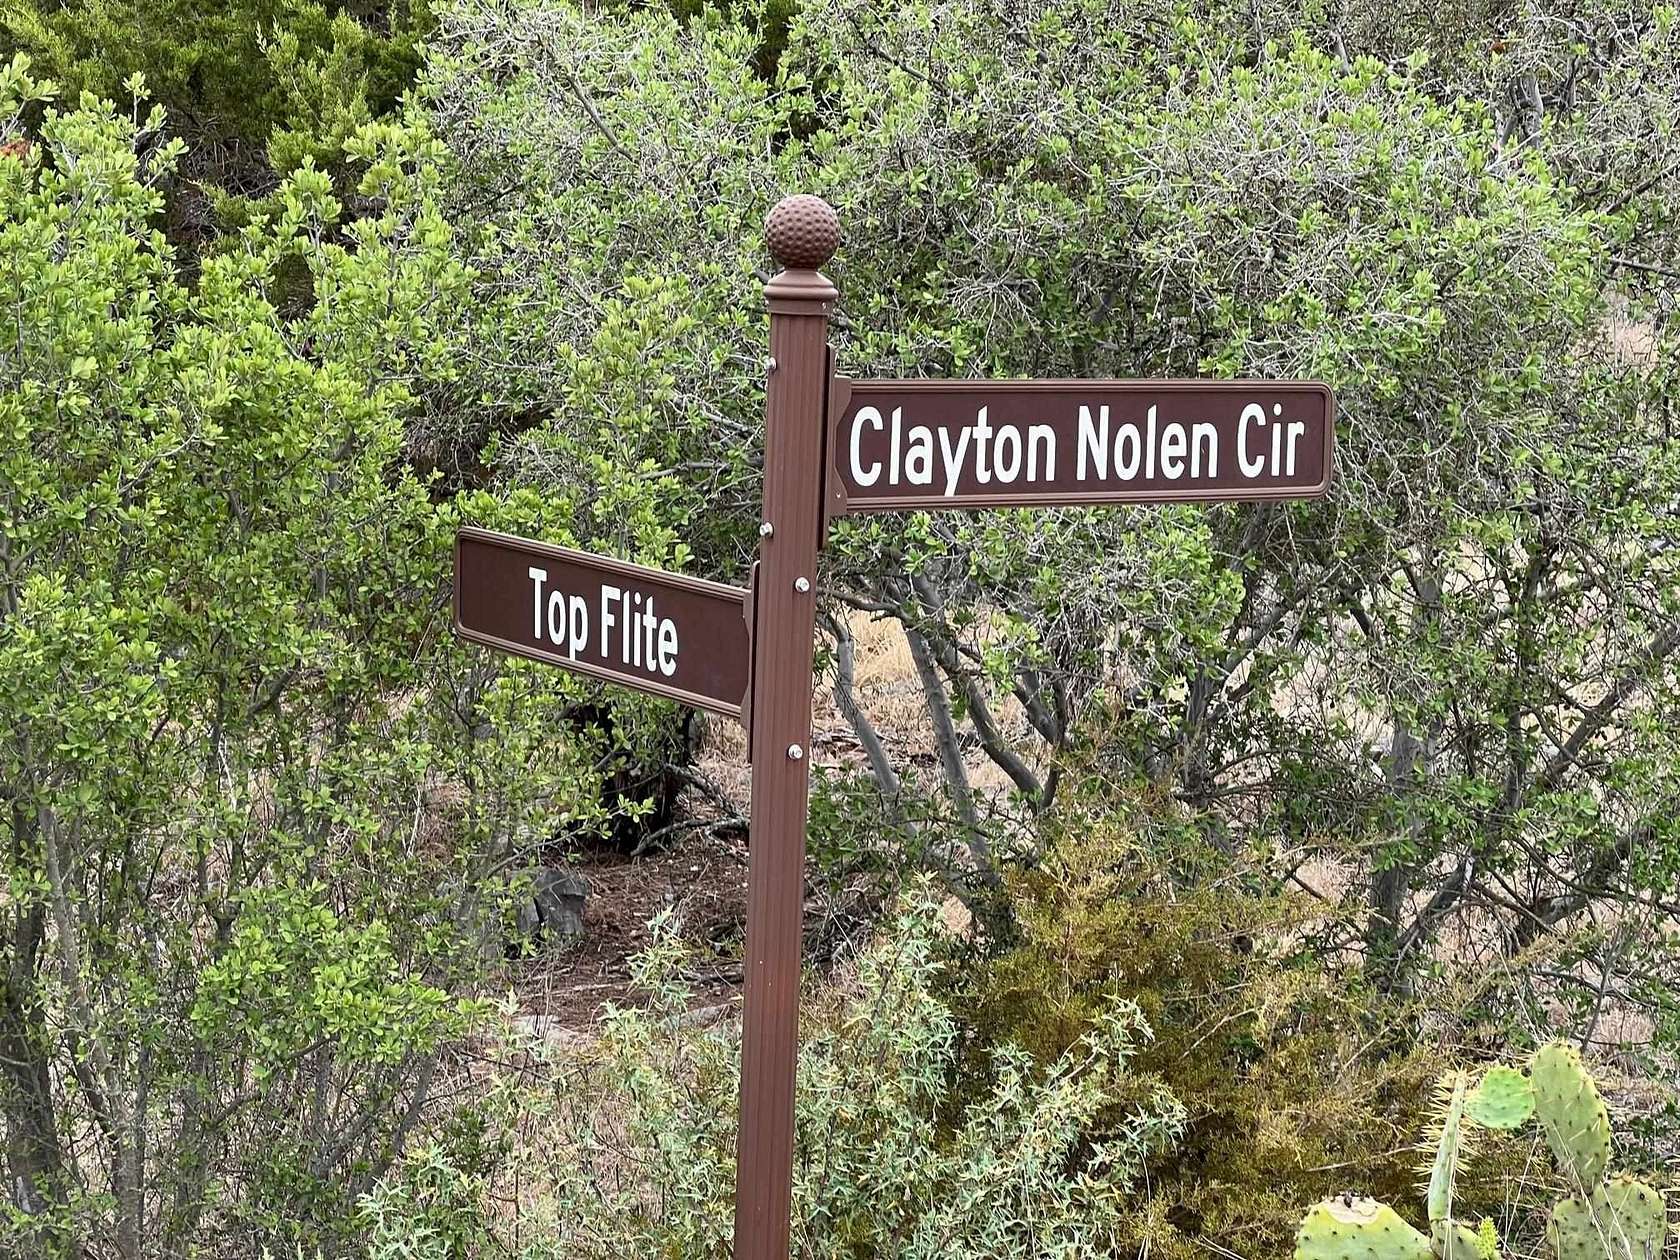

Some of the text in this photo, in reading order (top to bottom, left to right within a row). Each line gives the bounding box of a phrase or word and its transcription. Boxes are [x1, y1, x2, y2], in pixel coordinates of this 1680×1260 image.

[849, 402, 1305, 495] Clayton Nolen Cir
[529, 567, 679, 677] Top Flite
